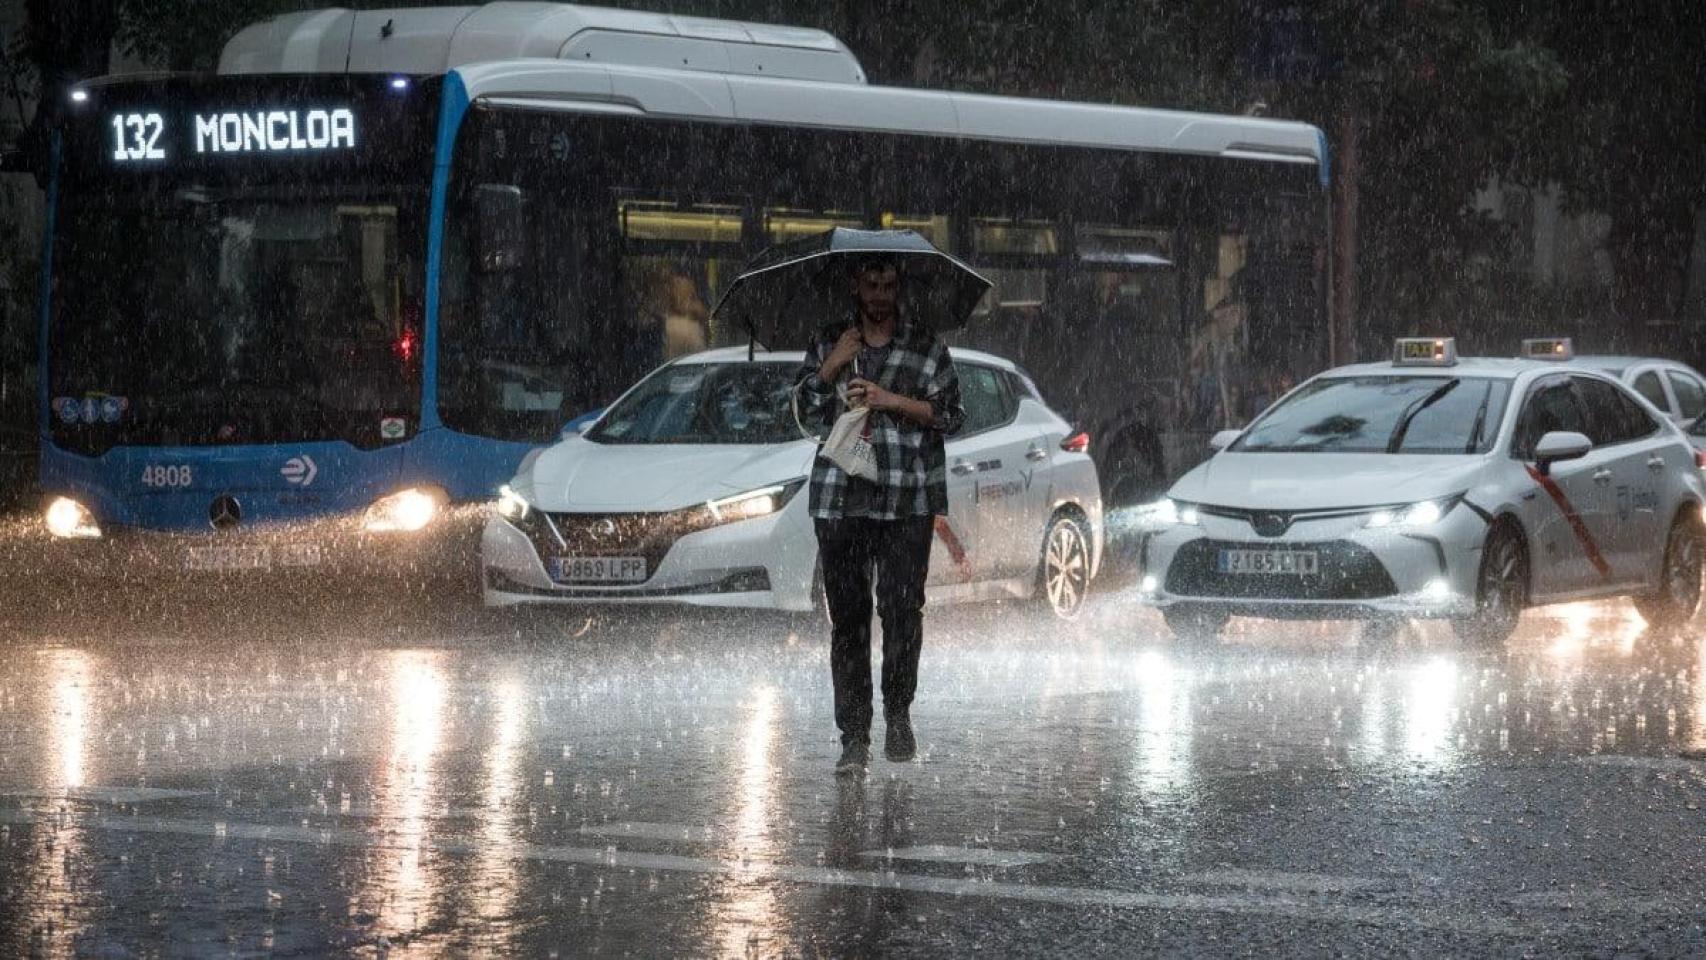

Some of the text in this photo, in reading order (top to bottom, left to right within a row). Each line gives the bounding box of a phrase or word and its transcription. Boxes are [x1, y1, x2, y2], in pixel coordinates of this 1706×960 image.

[112, 109, 355, 160] 132 MONCLOA
[141, 465, 192, 486] 4808
